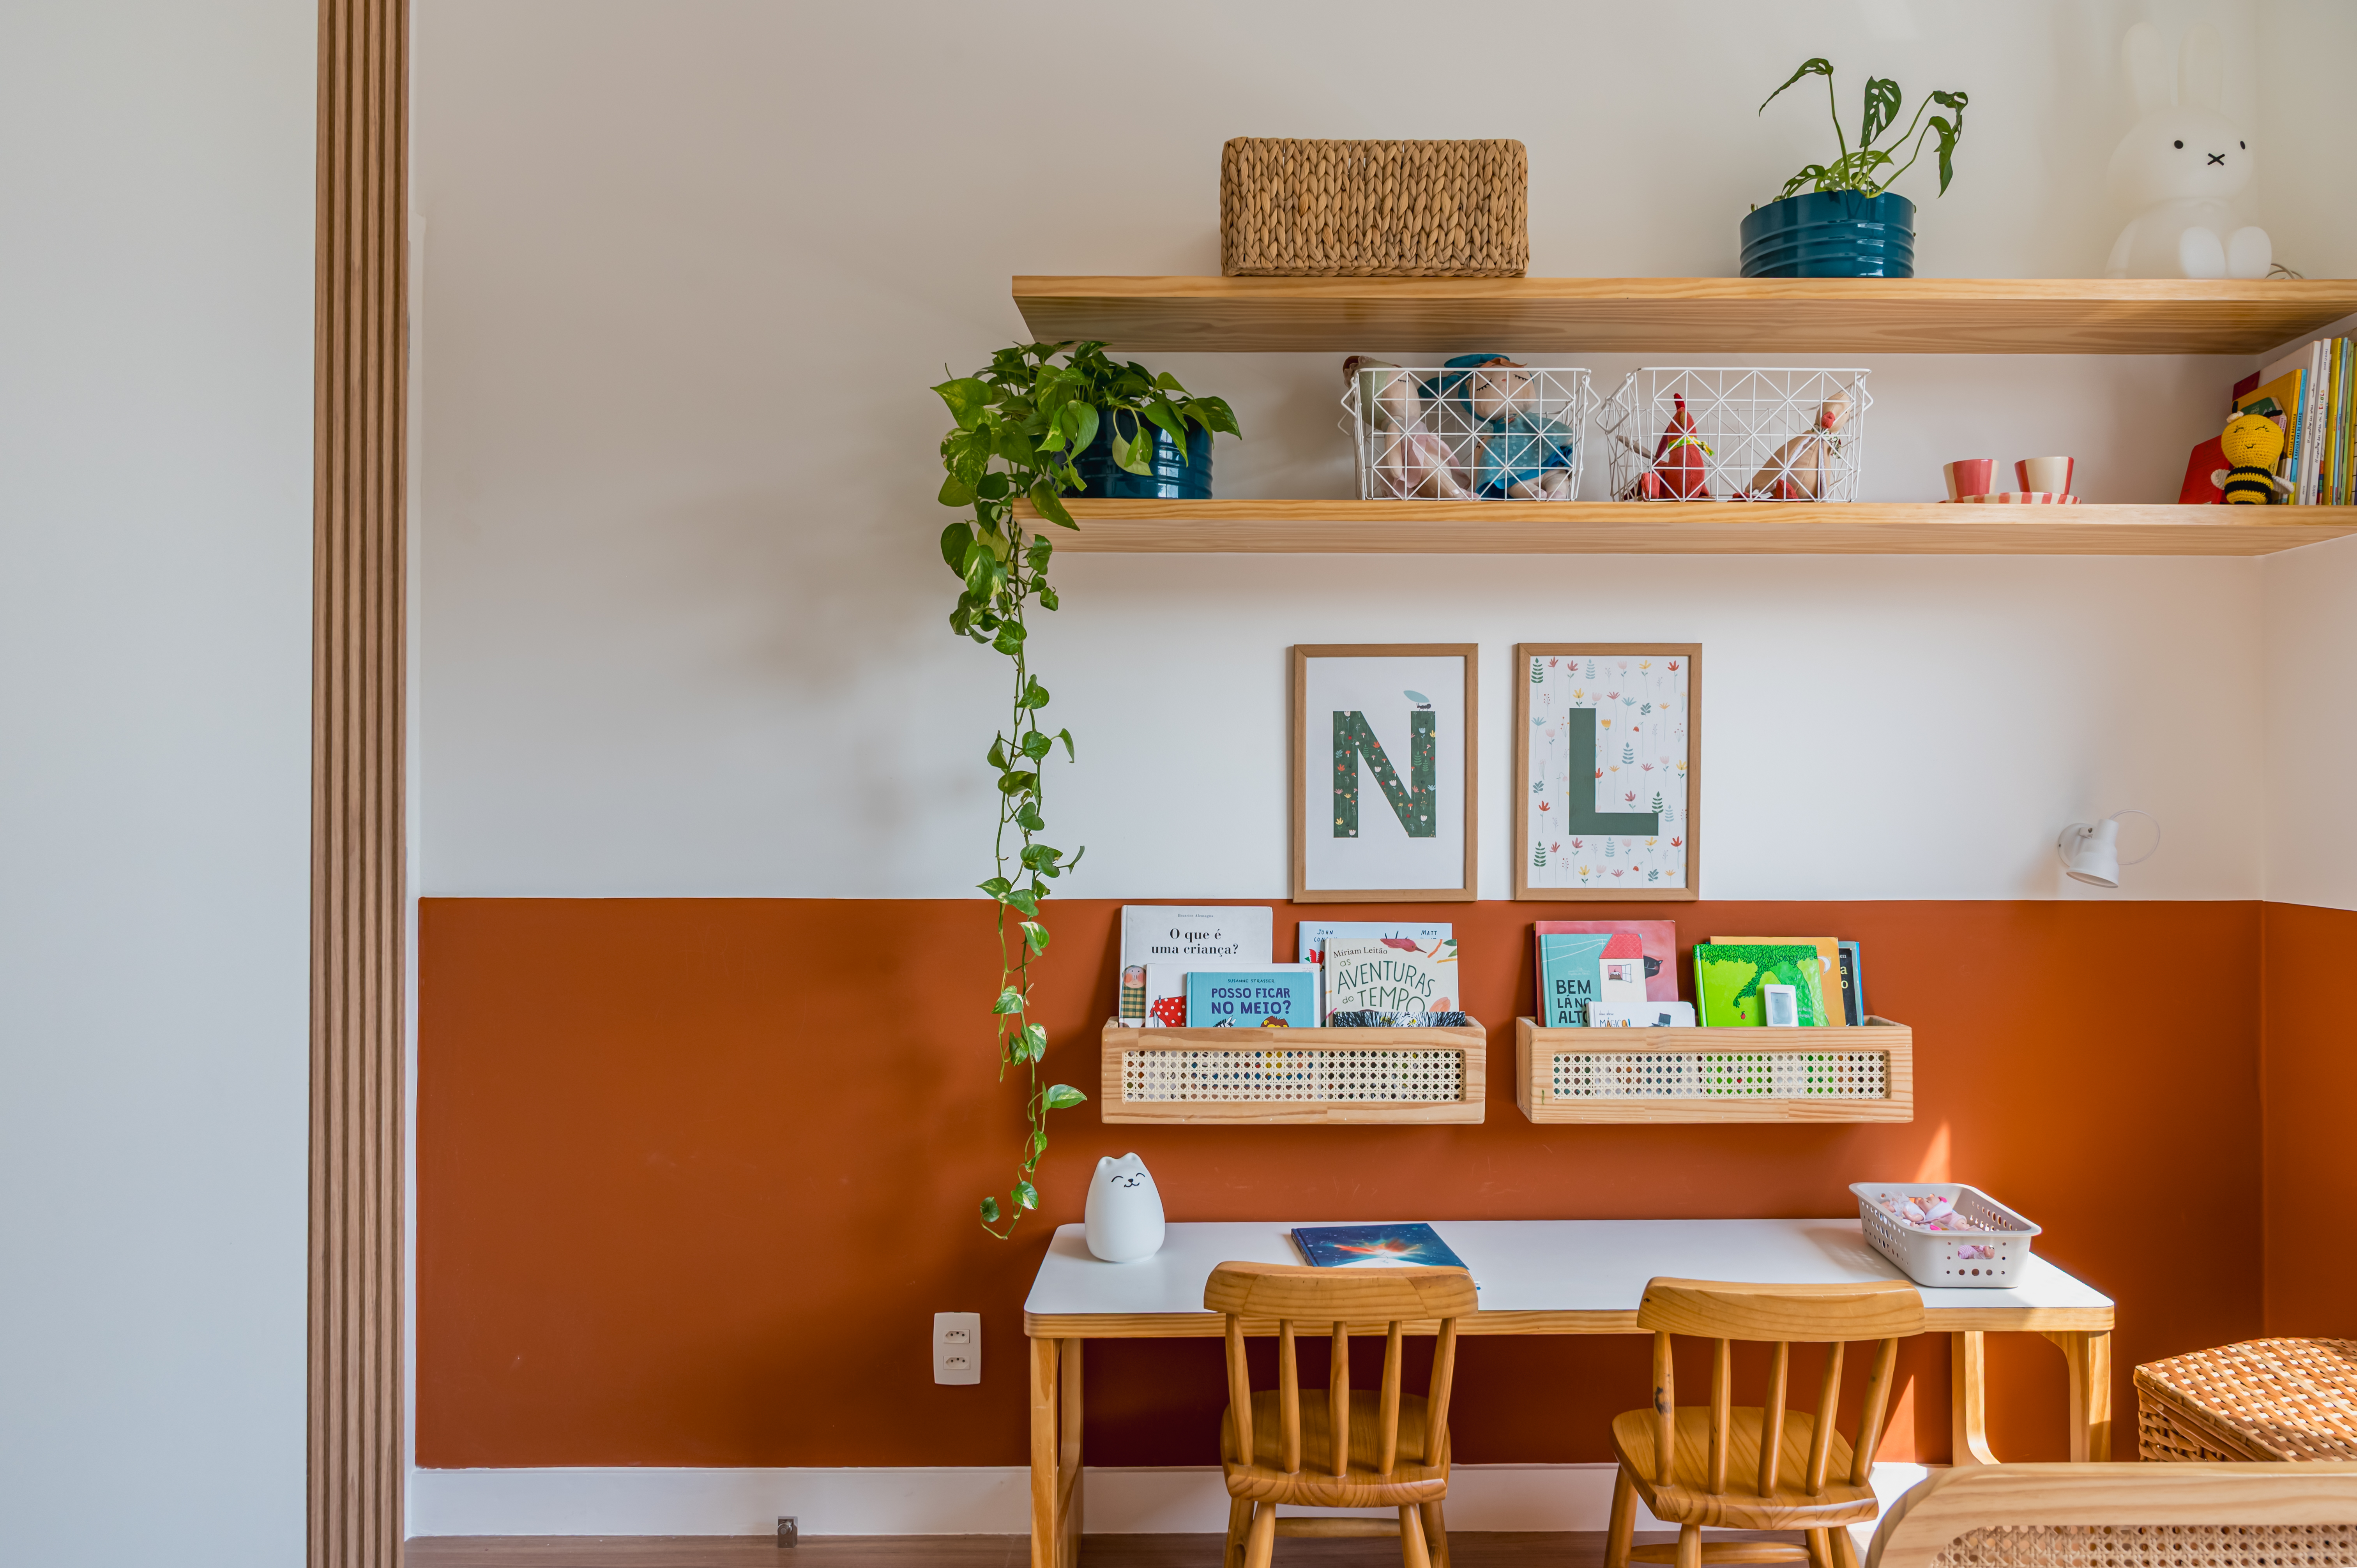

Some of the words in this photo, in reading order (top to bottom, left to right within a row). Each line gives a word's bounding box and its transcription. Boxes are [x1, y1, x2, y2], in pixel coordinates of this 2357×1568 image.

[1333, 711, 1436, 838] N
[1569, 708, 1659, 836] L
[1170, 928, 1180, 939] O
[1185, 932, 1210, 943] que
[1214, 929, 1221, 939] é
[1184, 943, 1238, 957] criança?
[1333, 948, 1361, 958] Míriam
[1338, 961, 1435, 997] AVENTURAS
[1212, 988, 1251, 998] POSSO
[1256, 988, 1290, 998] FICAR
[1556, 980, 1591, 994] BEM
[1357, 986, 1425, 1012] TEMPO
[1557, 994, 1572, 1008] LÁ
[1211, 1001, 1234, 1014] NO
[1240, 1000, 1291, 1014] MEIO?
